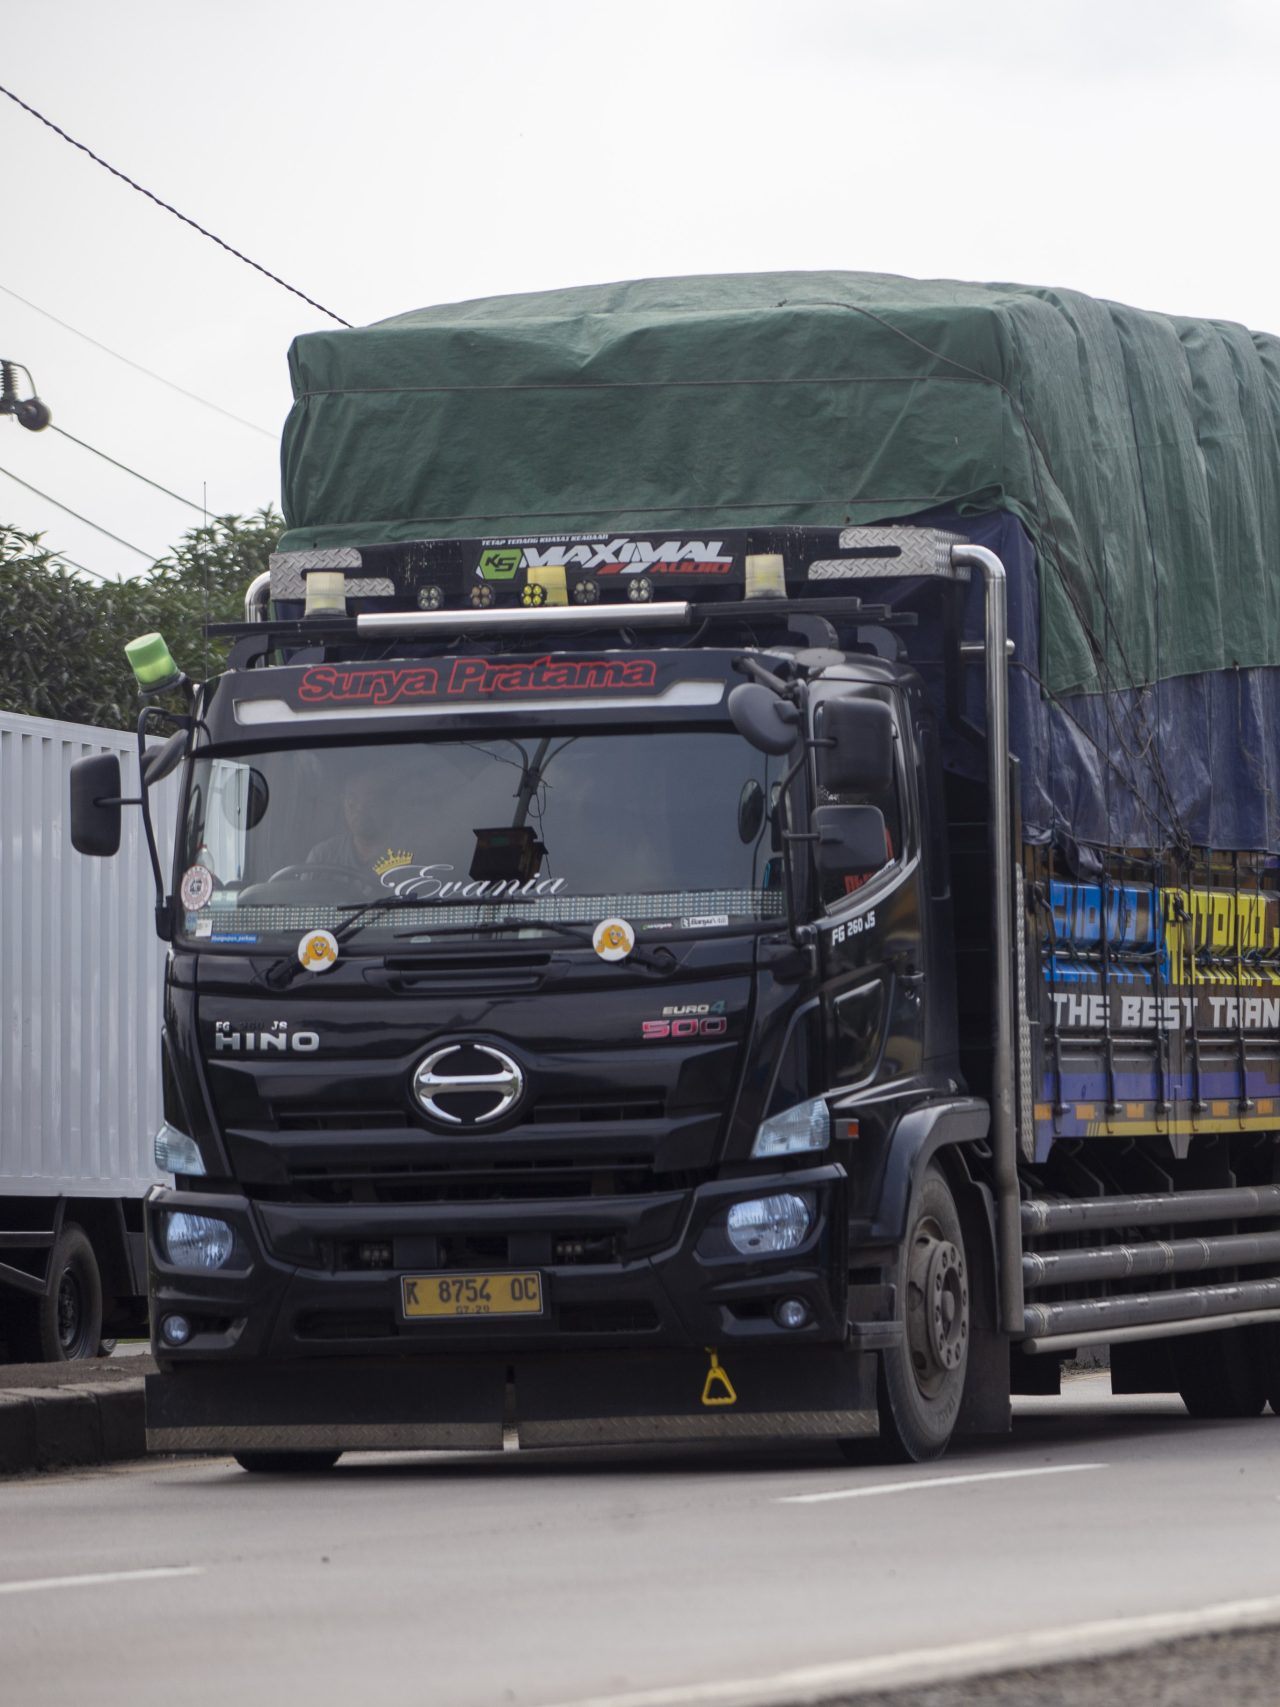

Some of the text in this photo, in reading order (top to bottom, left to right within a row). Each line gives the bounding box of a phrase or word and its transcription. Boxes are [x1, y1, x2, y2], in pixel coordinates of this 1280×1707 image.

[571, 534, 609, 542] KEADAAN
[519, 538, 733, 572] MAXIMAL
[651, 562, 732, 575] AUDIO
[299, 656, 657, 705] Surya Pratama
[380, 863, 569, 900] Evania
[832, 910, 876, 947] FG 260 JS
[1048, 992, 1110, 1028] THE
[1121, 995, 1199, 1030] BEST
[215, 1021, 231, 1032] FG
[642, 1017, 727, 1039] 500
[215, 1031, 320, 1052] HINO
[405, 1281, 419, 1306] K
[438, 1278, 492, 1303] 8754
